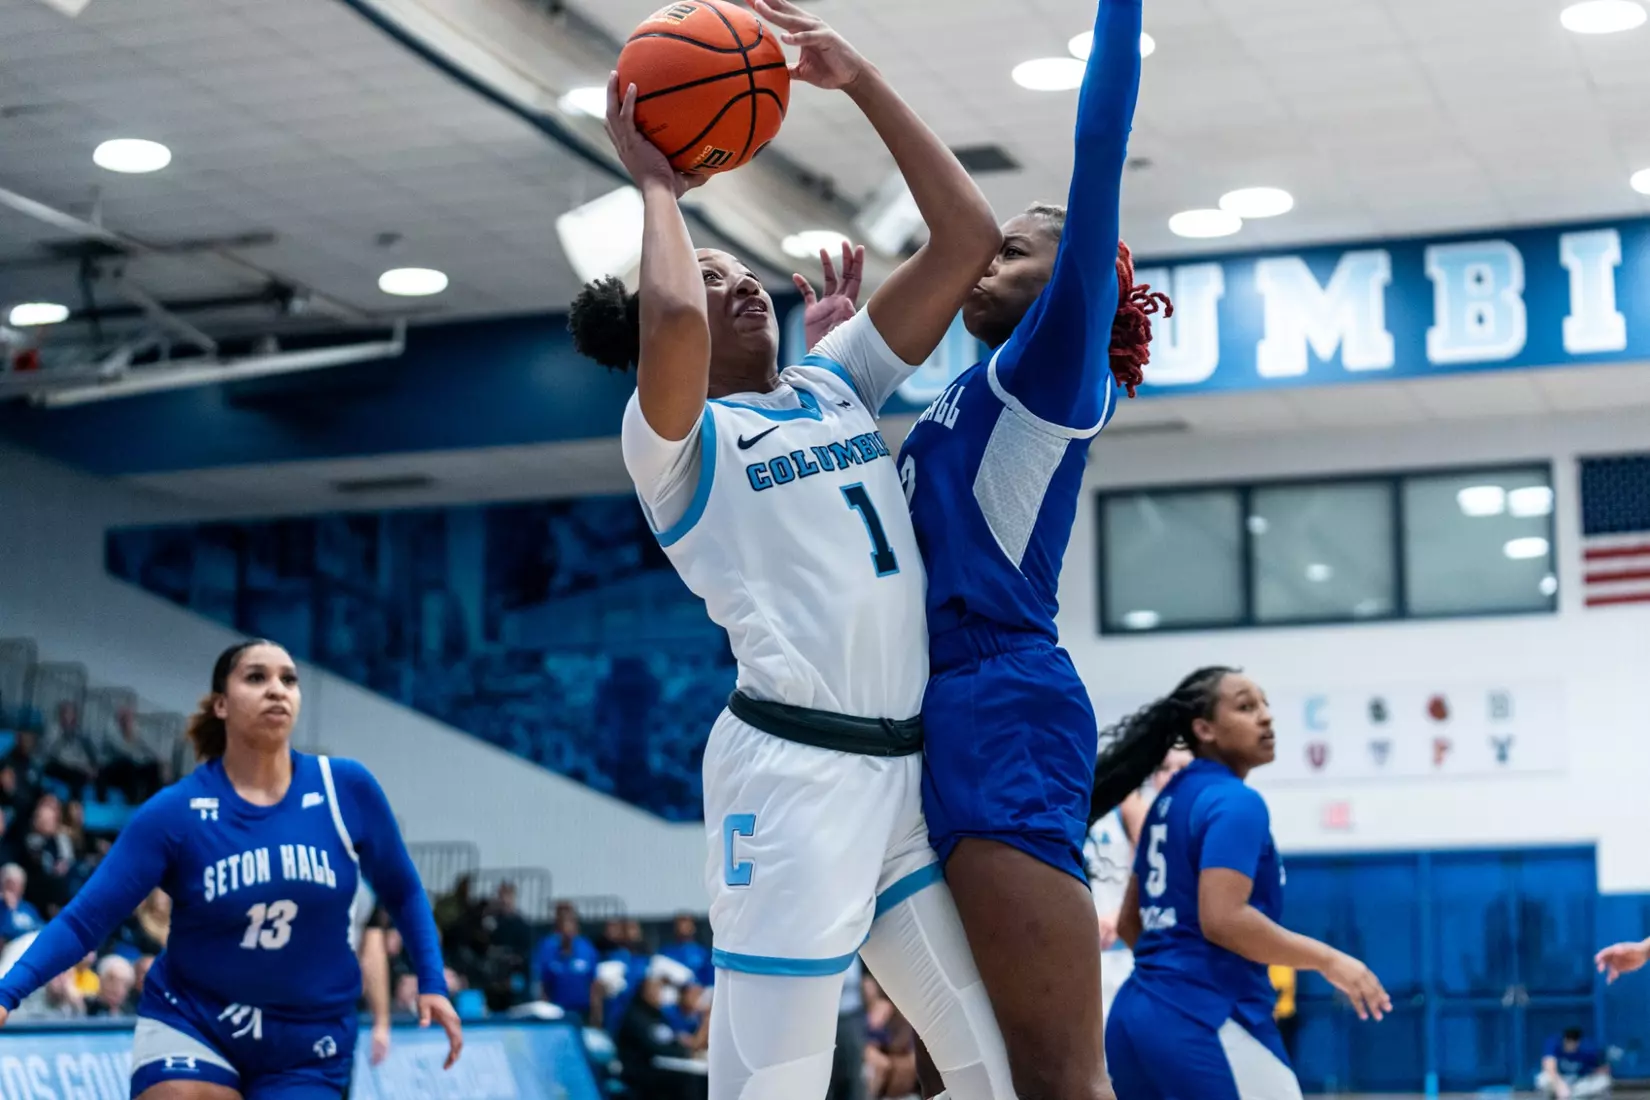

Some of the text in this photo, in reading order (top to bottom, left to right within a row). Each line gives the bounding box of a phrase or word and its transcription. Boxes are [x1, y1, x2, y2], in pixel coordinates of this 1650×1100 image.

[839, 481, 900, 578] 1
[203, 844, 337, 903] SETON HALL
[723, 813, 757, 887] C
[1145, 823, 1168, 898] 5
[239, 899, 298, 950] 13
